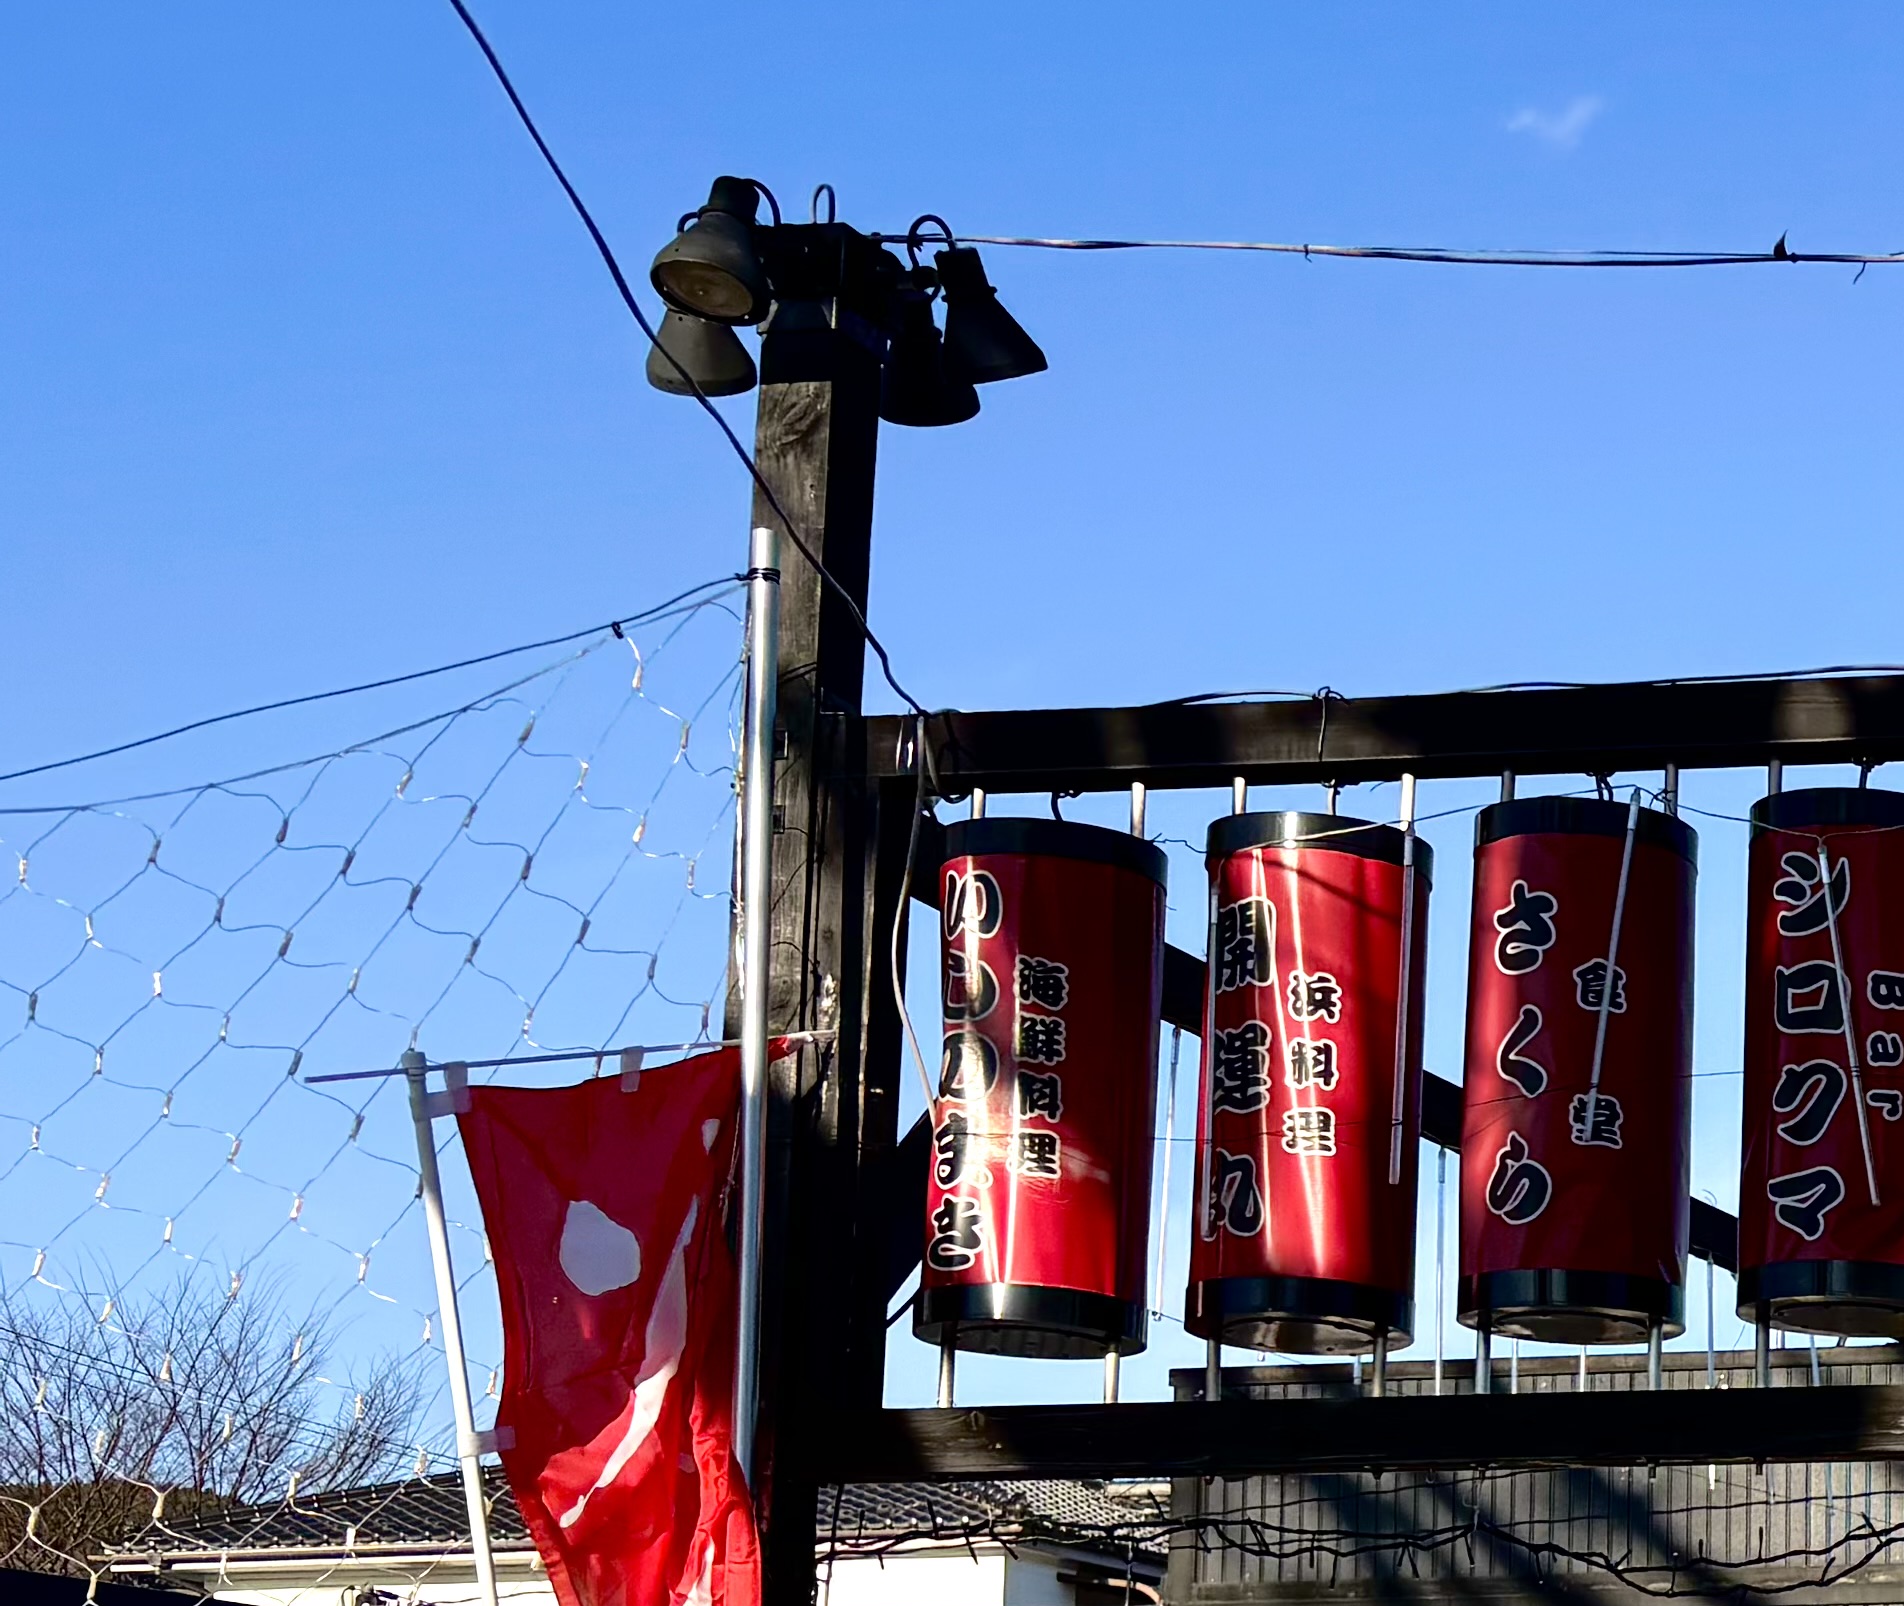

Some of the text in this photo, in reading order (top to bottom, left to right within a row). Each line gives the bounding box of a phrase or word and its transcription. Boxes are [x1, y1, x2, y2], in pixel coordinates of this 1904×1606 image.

[928, 870, 1003, 1271] いしのまき
[1008, 956, 1069, 1178] 海鮮料理
[1205, 897, 1276, 1241] 開運丸
[1282, 972, 1341, 1156] 浜料理
[1486, 880, 1557, 1225] さくら
[1569, 958, 1627, 1149] 食堂
[1768, 851, 1851, 1241] シロクマ
